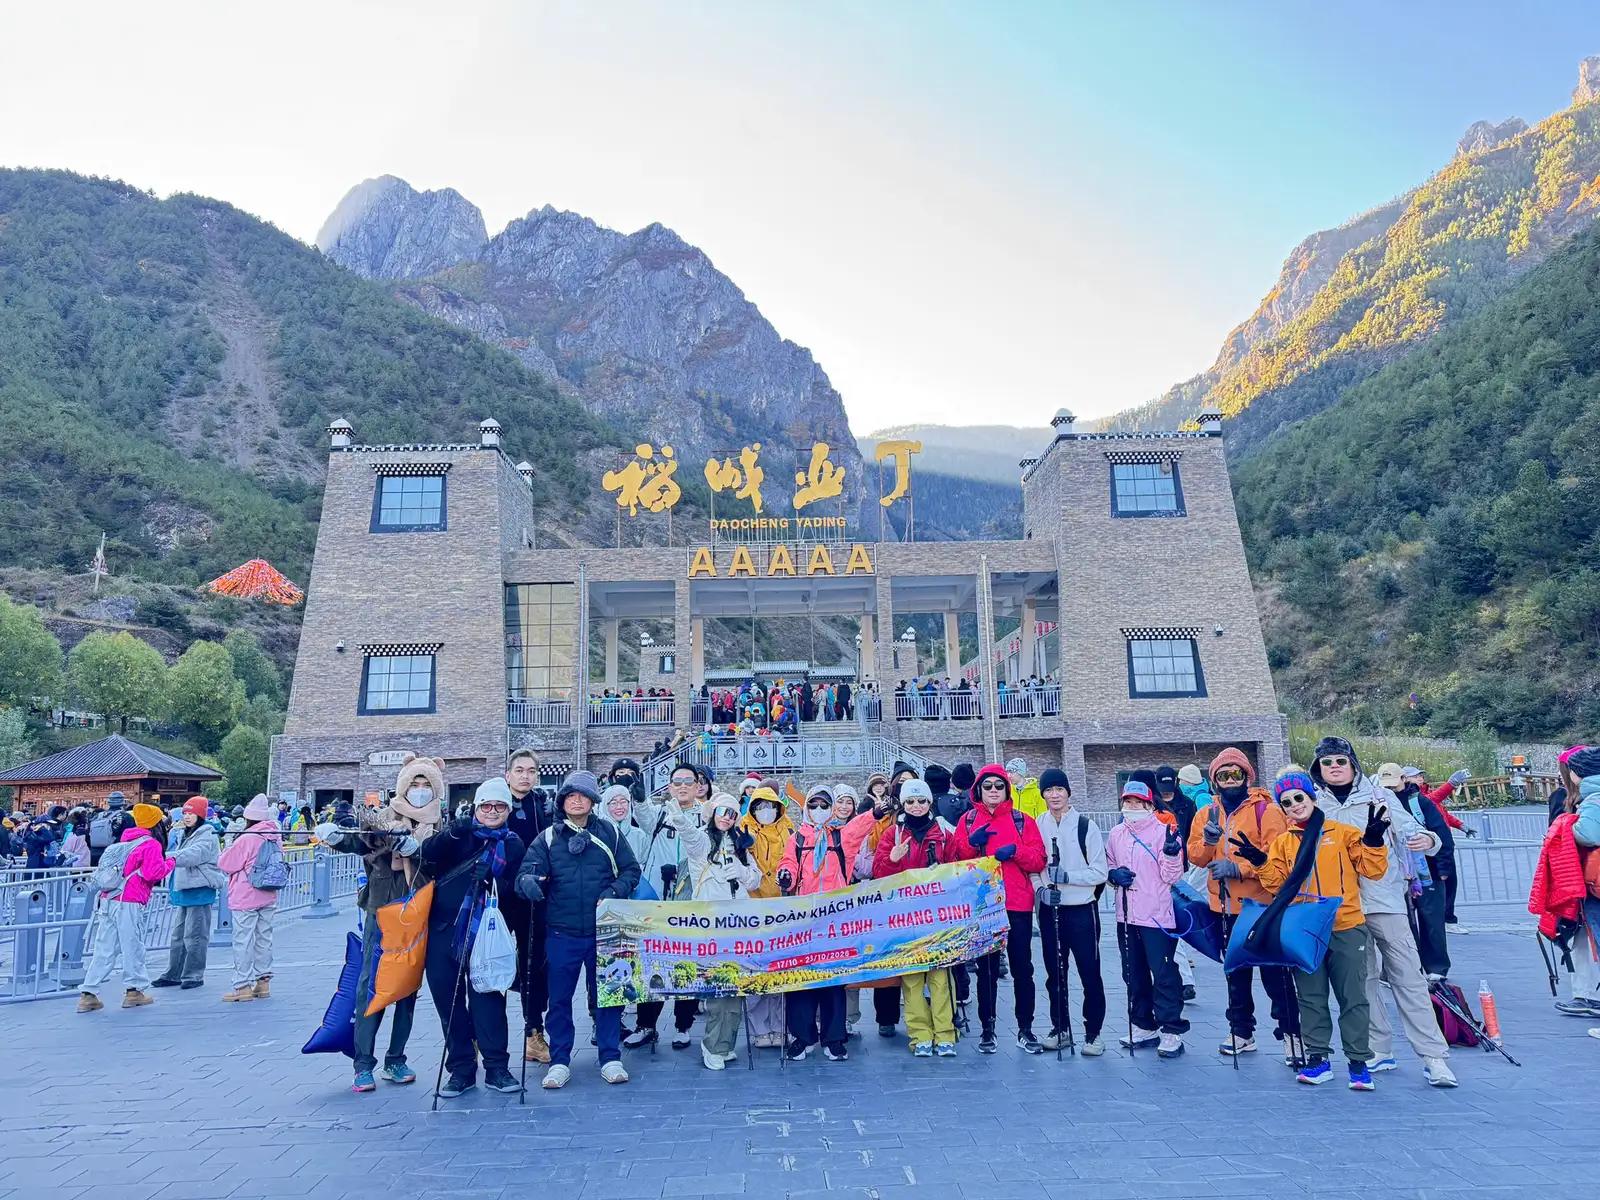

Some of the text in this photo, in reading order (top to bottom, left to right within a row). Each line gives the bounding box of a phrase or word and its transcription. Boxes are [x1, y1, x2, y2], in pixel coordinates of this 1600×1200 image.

[710, 516, 846, 530] DAOCHENG YADING
[668, 881, 946, 929] CHÀO MỪNG ĐOÀN KHÁCH NHÀ J TRAVEL
[643, 936, 692, 956] THÀNH
[697, 938, 718, 957] ĐÔ
[734, 940, 764, 958] ĐẠO
[769, 928, 812, 950] THÀNH
[888, 908, 934, 929] KHANG
[938, 903, 971, 925] ĐỊNH
[776, 958, 798, 969] 17/10
